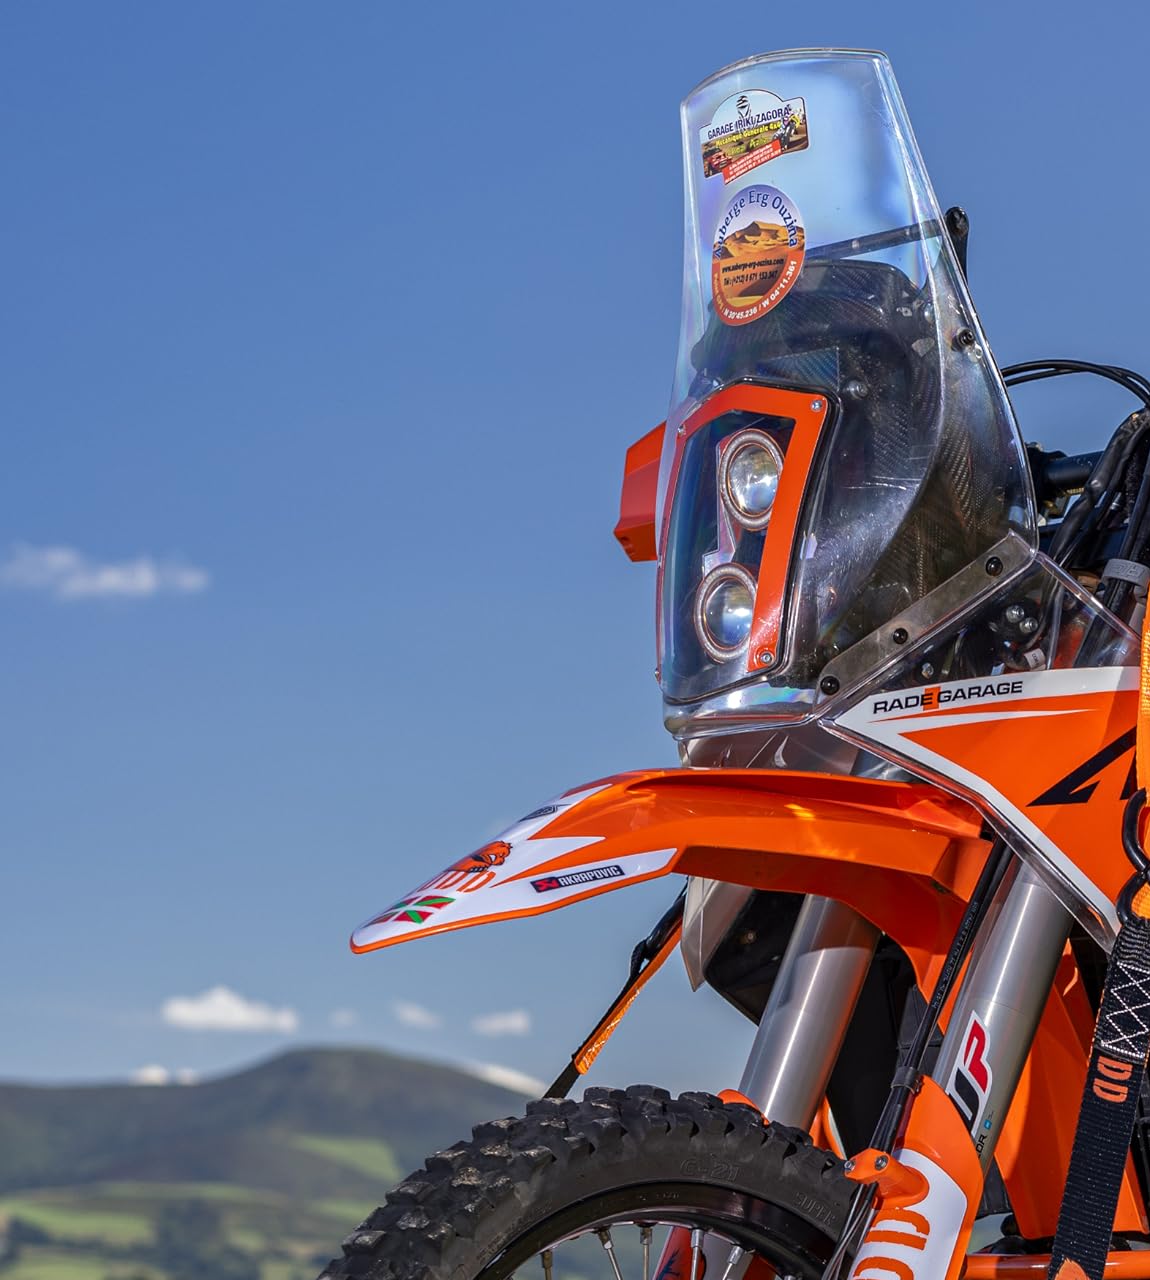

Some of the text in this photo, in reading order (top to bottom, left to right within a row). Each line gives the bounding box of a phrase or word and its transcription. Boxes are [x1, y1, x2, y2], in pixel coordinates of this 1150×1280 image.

[708, 122, 734, 139] GARAGE
[756, 105, 790, 124] ZAGORA
[714, 190, 798, 260] Auberge Erg Ouzina
[873, 681, 1024, 714] RADE GARAGE
